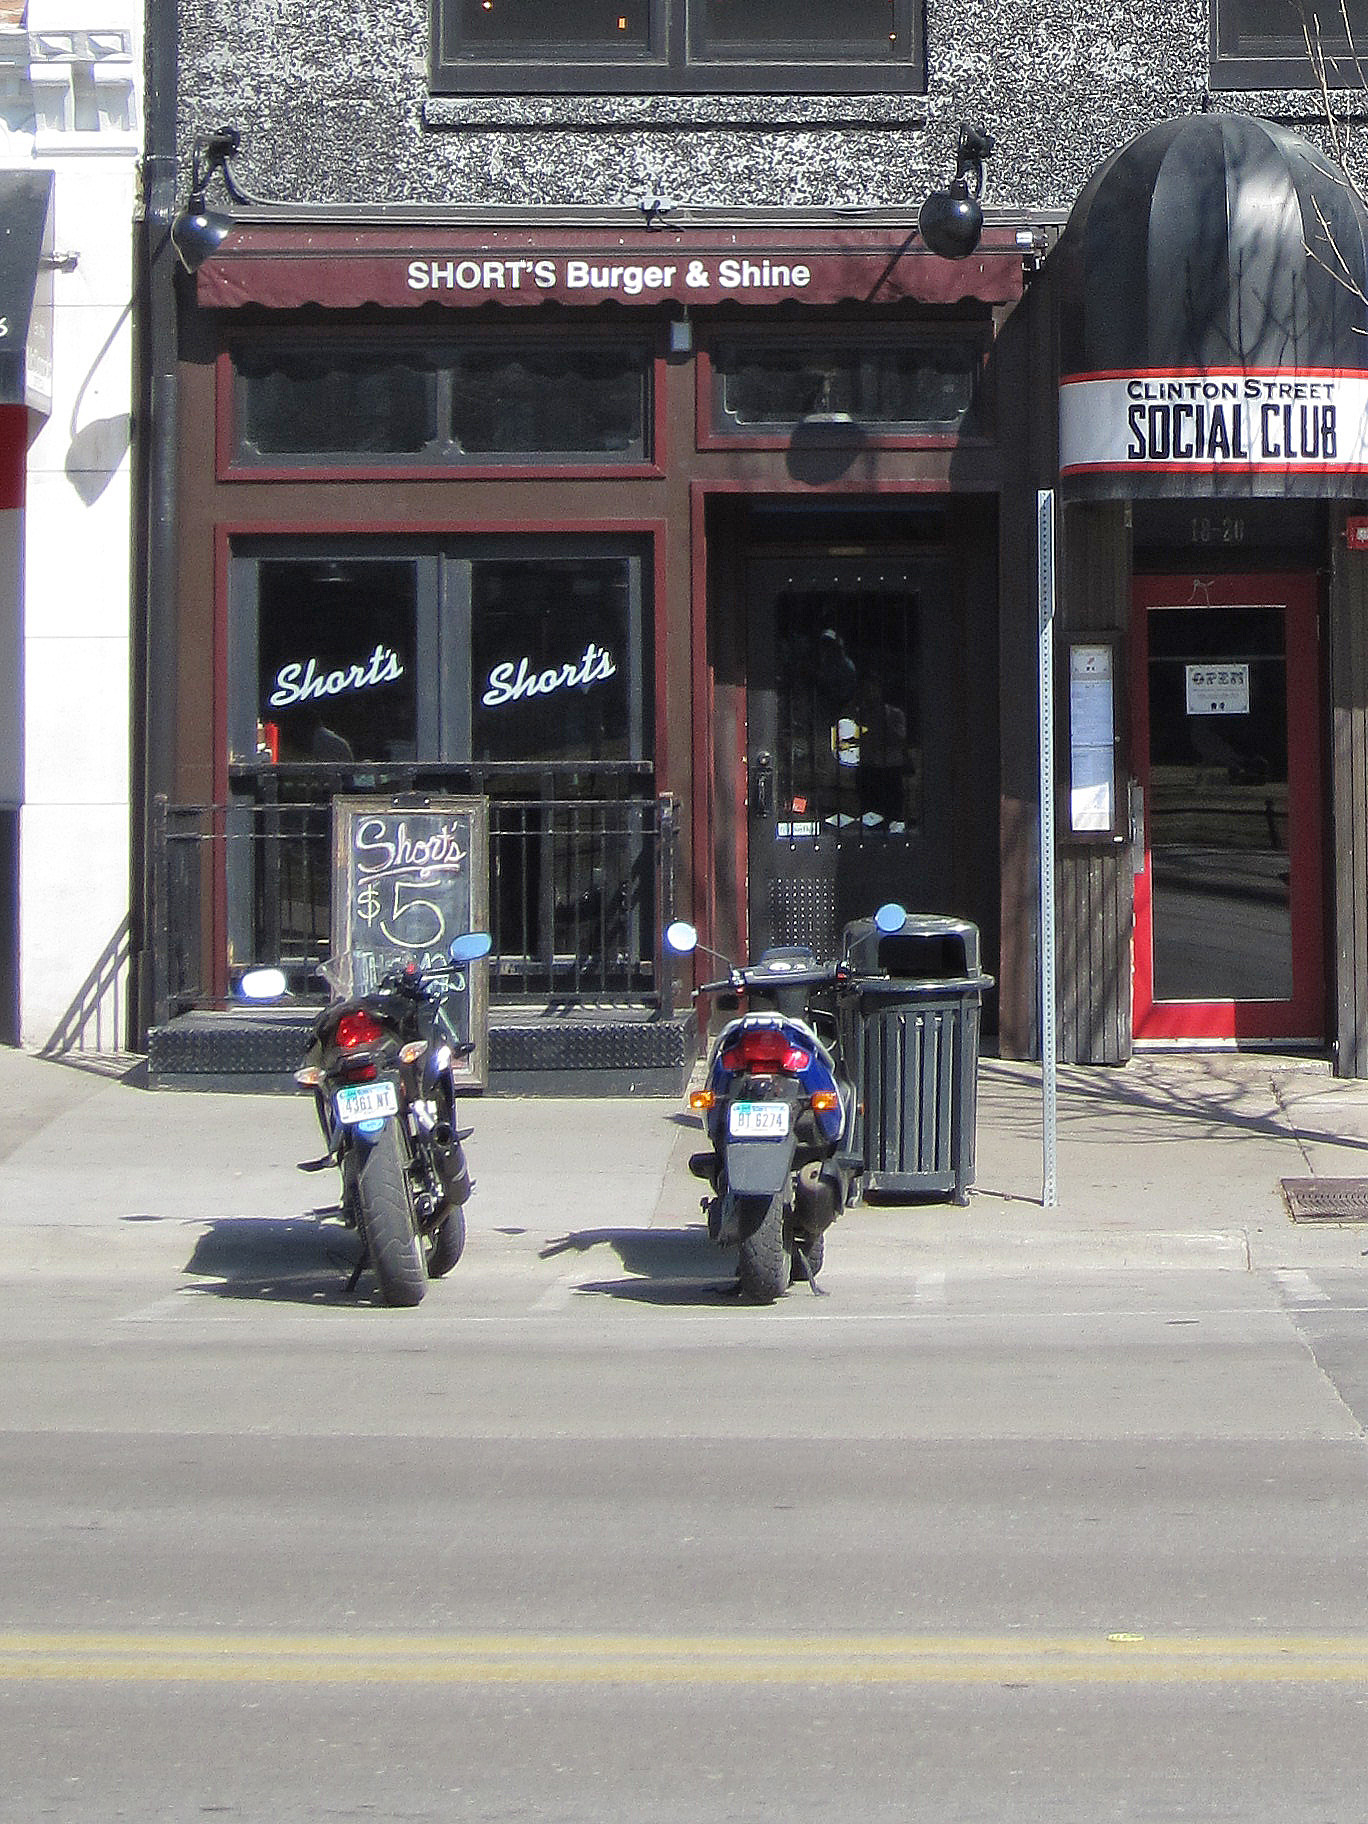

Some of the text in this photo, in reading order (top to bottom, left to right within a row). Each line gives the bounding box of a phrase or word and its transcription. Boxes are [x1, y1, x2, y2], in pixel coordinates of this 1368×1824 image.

[407, 260, 811, 294] SHORT'S Burger & Shine
[1127, 379, 1335, 400] CLINTON STREET
[1128, 403, 1337, 460] SOCIAL CLUB
[270, 644, 404, 708] Short's
[482, 643, 617, 707] Short's
[355, 819, 467, 873] Short's
